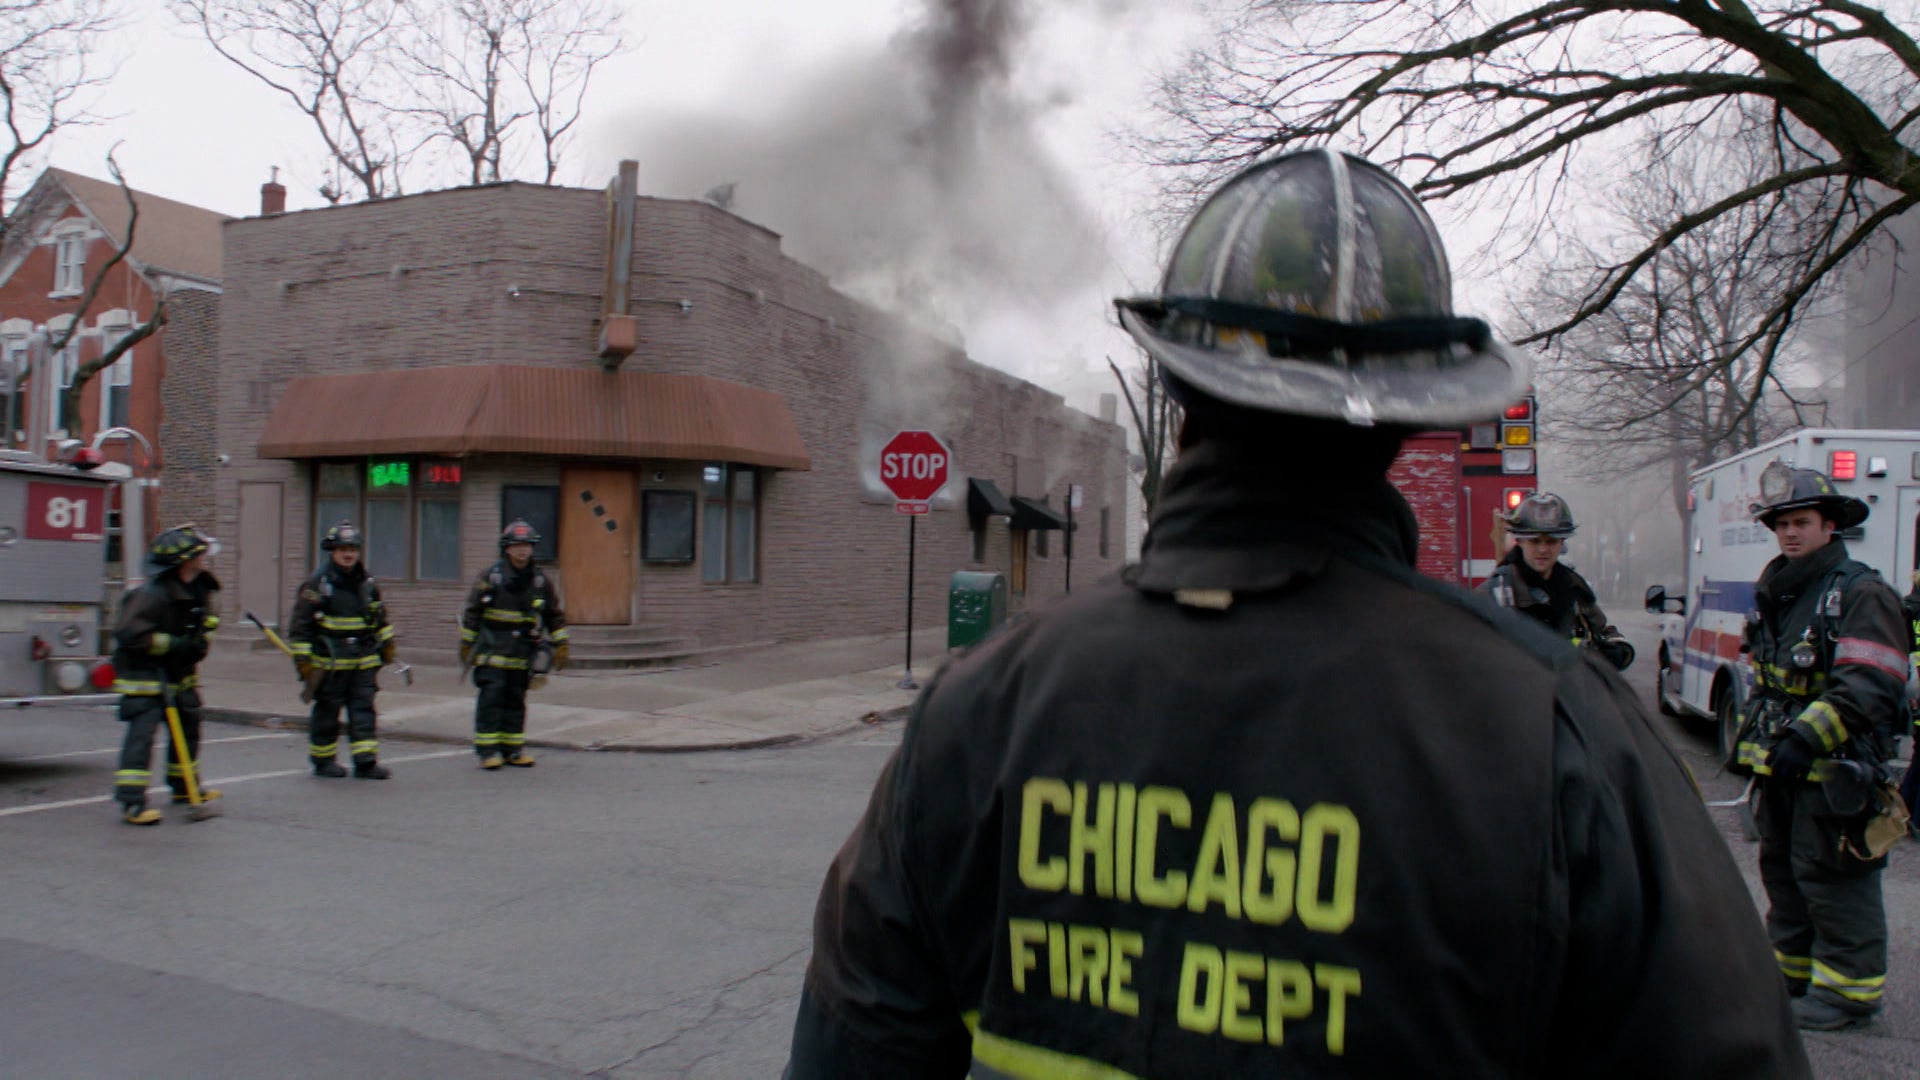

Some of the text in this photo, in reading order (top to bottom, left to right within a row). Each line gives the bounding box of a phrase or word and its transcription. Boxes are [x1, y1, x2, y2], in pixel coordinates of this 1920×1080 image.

[883, 453, 945, 479] STOP
[46, 497, 88, 528] 81
[1018, 776, 1361, 934] CHICAGO
[1008, 917, 1362, 1056] FIRE DEPT
